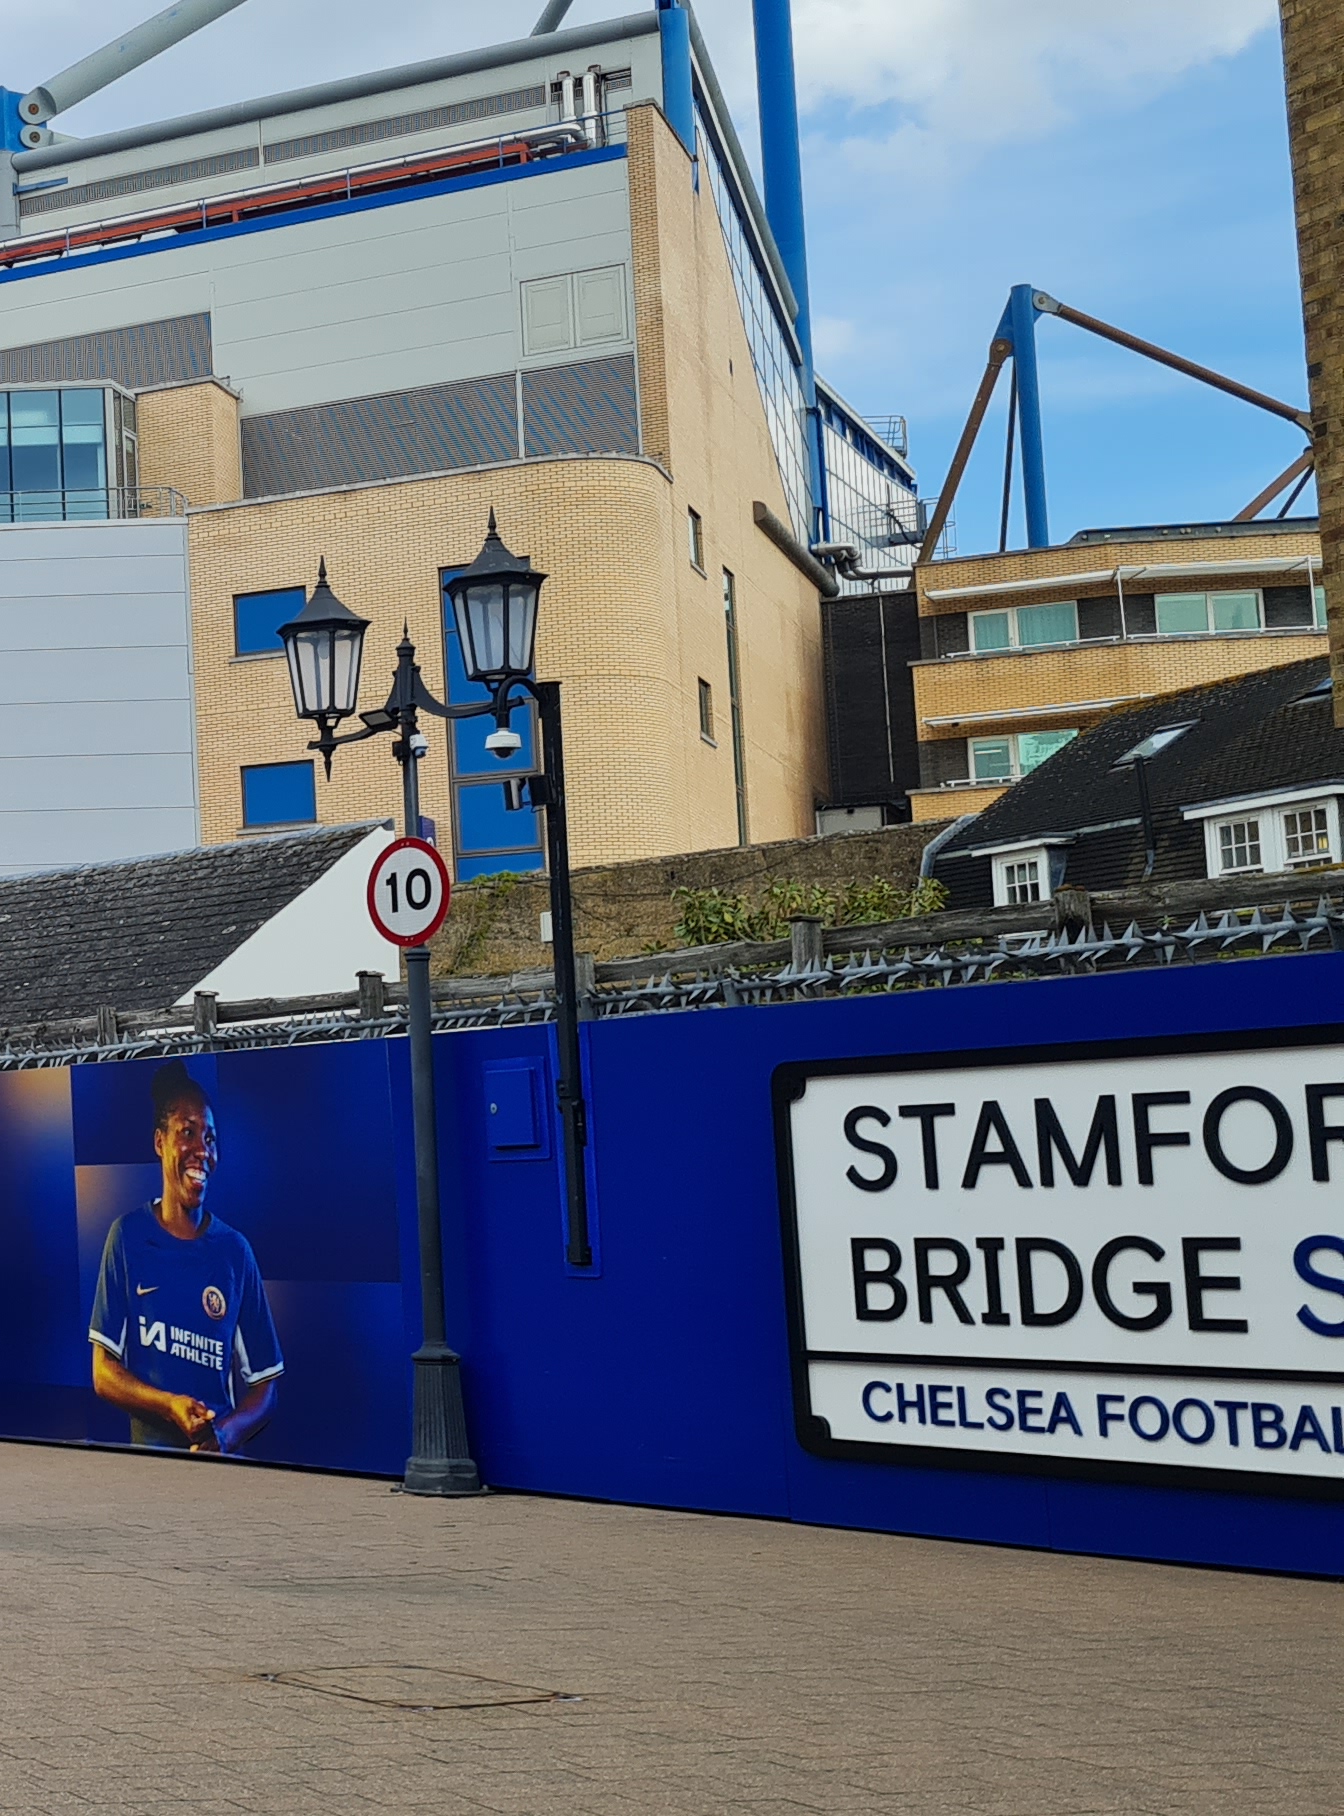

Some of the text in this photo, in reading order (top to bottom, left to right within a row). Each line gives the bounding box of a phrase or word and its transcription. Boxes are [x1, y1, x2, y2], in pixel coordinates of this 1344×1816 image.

[385, 868, 432, 913] 10
[850, 1235, 1249, 1334] BRIDGE
[170, 1325, 224, 1356] INFINITE
[170, 1343, 224, 1371] ATHLETE
[861, 1380, 1083, 1438] CHELSEA
